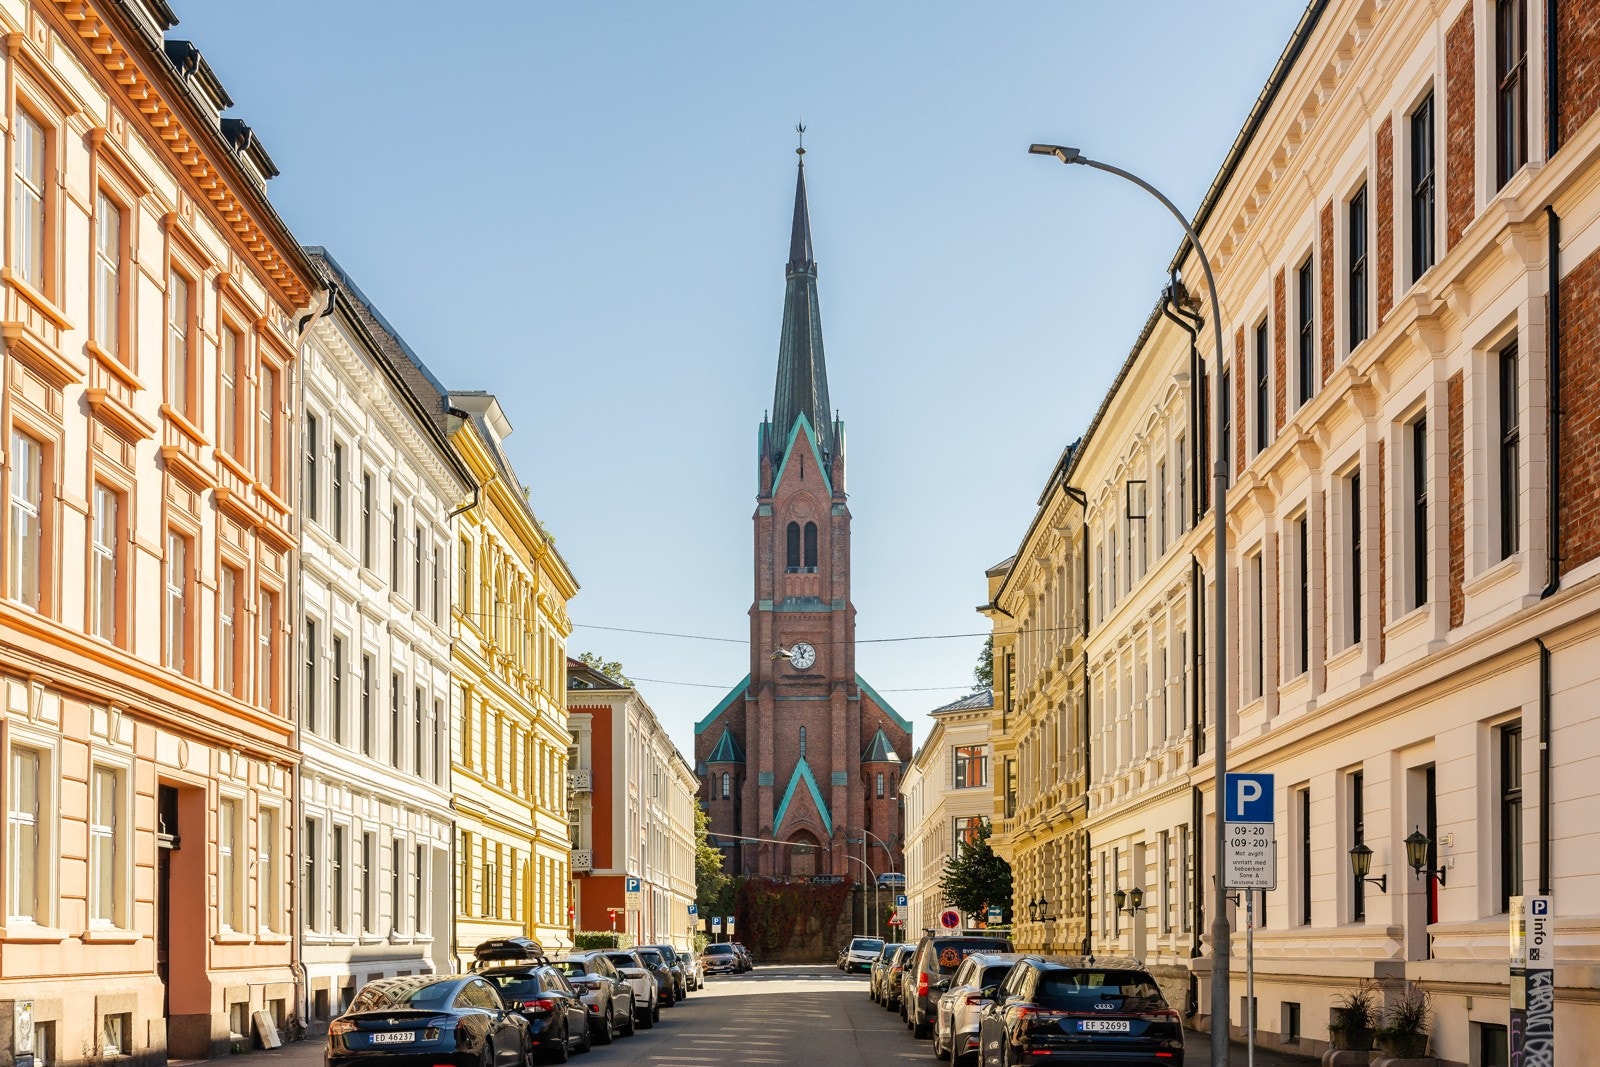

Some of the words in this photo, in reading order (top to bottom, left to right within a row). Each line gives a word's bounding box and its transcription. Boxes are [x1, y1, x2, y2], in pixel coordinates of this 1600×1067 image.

[1237, 780, 1262, 816] P
[630, 880, 637, 890] P
[1534, 902, 1545, 914] P
[1534, 918, 1546, 945] info
[1100, 1022, 1127, 1030] 52699
